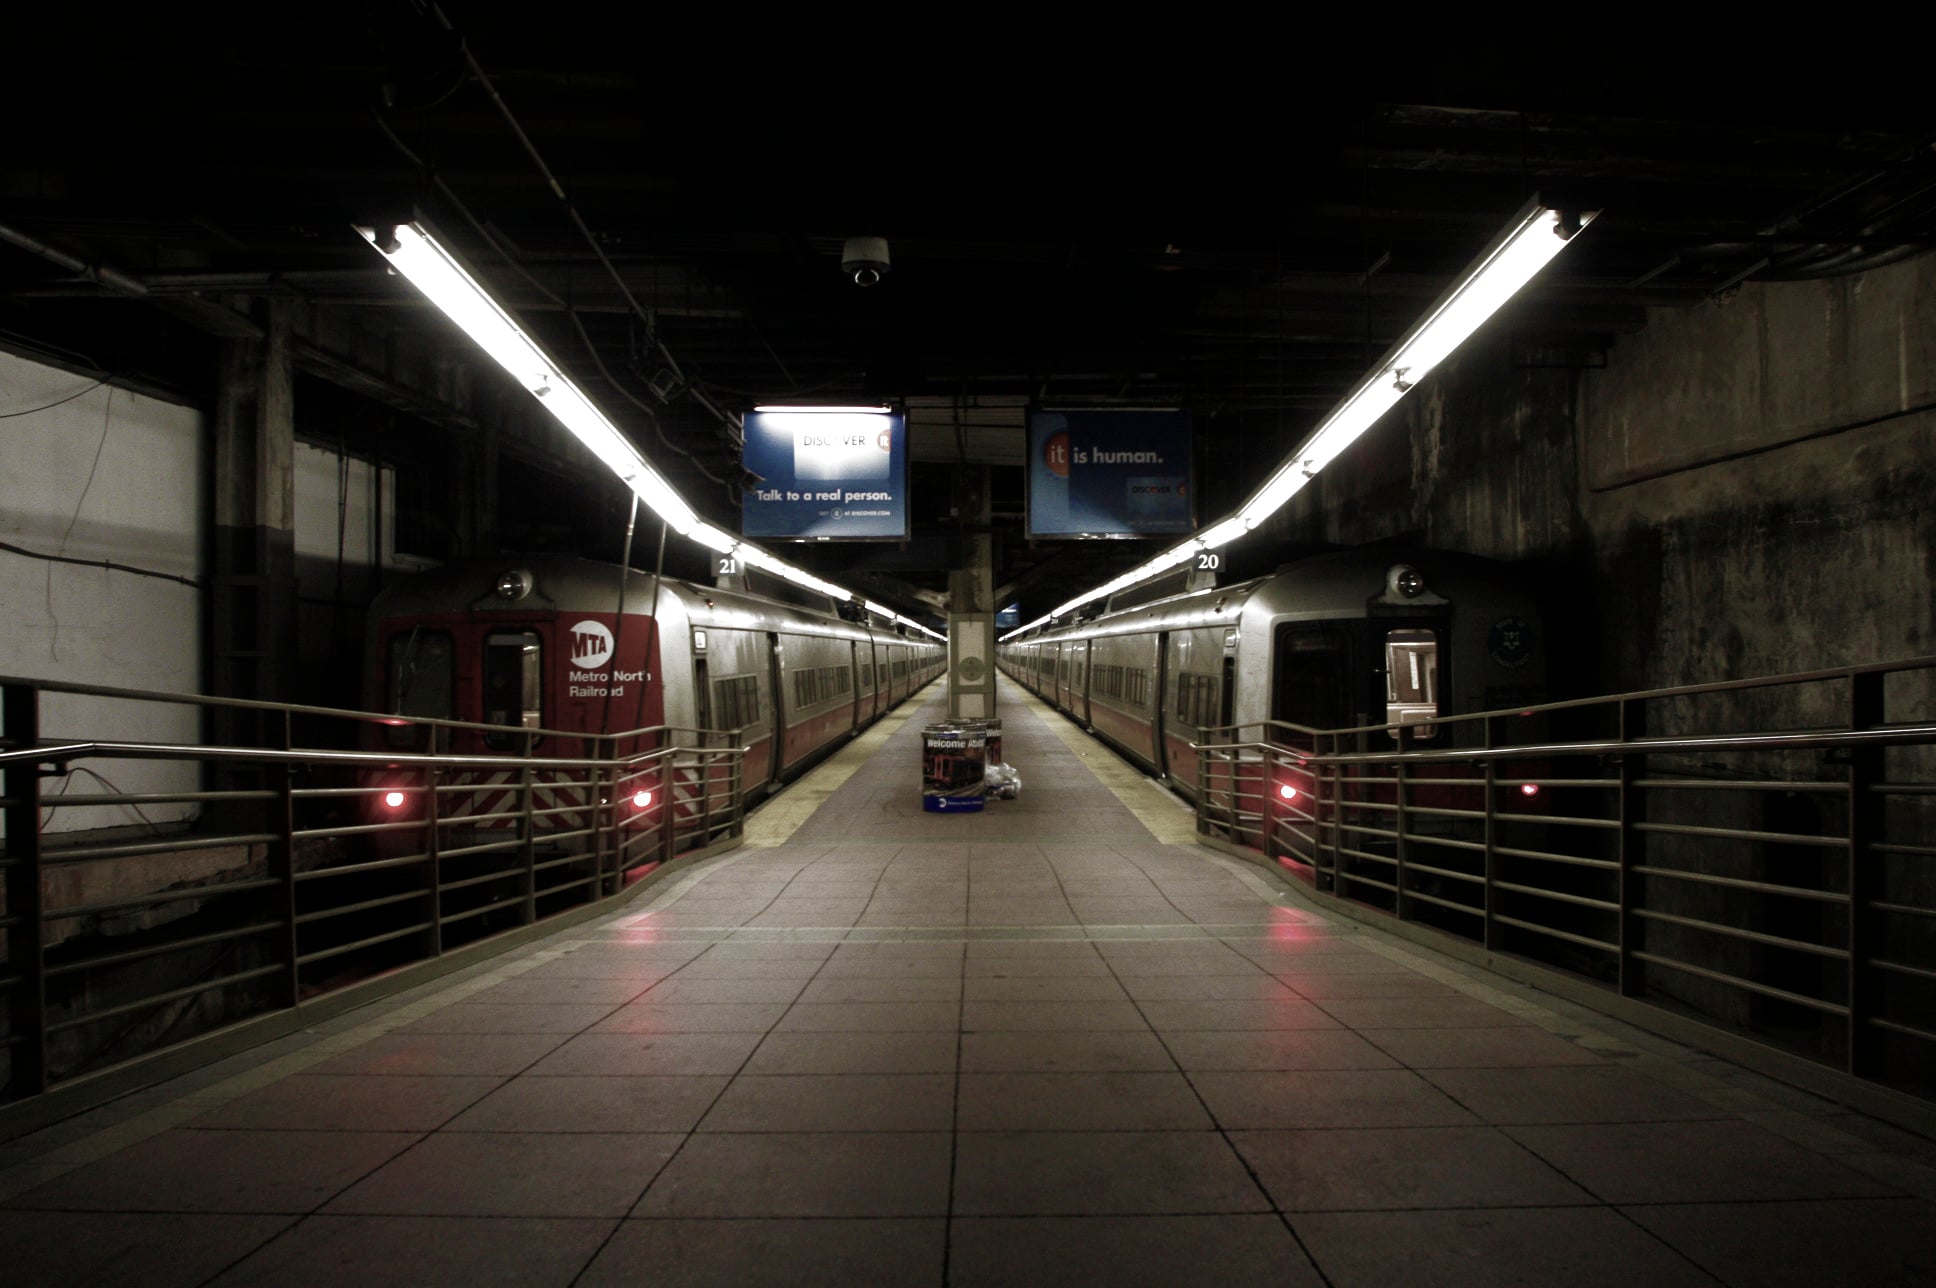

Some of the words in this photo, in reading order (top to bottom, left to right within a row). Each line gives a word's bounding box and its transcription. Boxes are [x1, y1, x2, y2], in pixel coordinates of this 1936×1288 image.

[803, 435, 866, 446] DISCVER
[1050, 445, 1065, 464] it
[1073, 447, 1088, 464] is
[1092, 446, 1164, 464] human.
[756, 489, 783, 501] Talk
[786, 490, 800, 501] to
[803, 491, 812, 501] a
[816, 488, 841, 501] real
[845, 491, 892, 503] person.
[719, 558, 736, 574] 21
[1198, 554, 1219, 569] 20
[569, 628, 607, 659] MTA
[569, 671, 609, 682] Metro
[927, 740, 966, 749] Welcome
